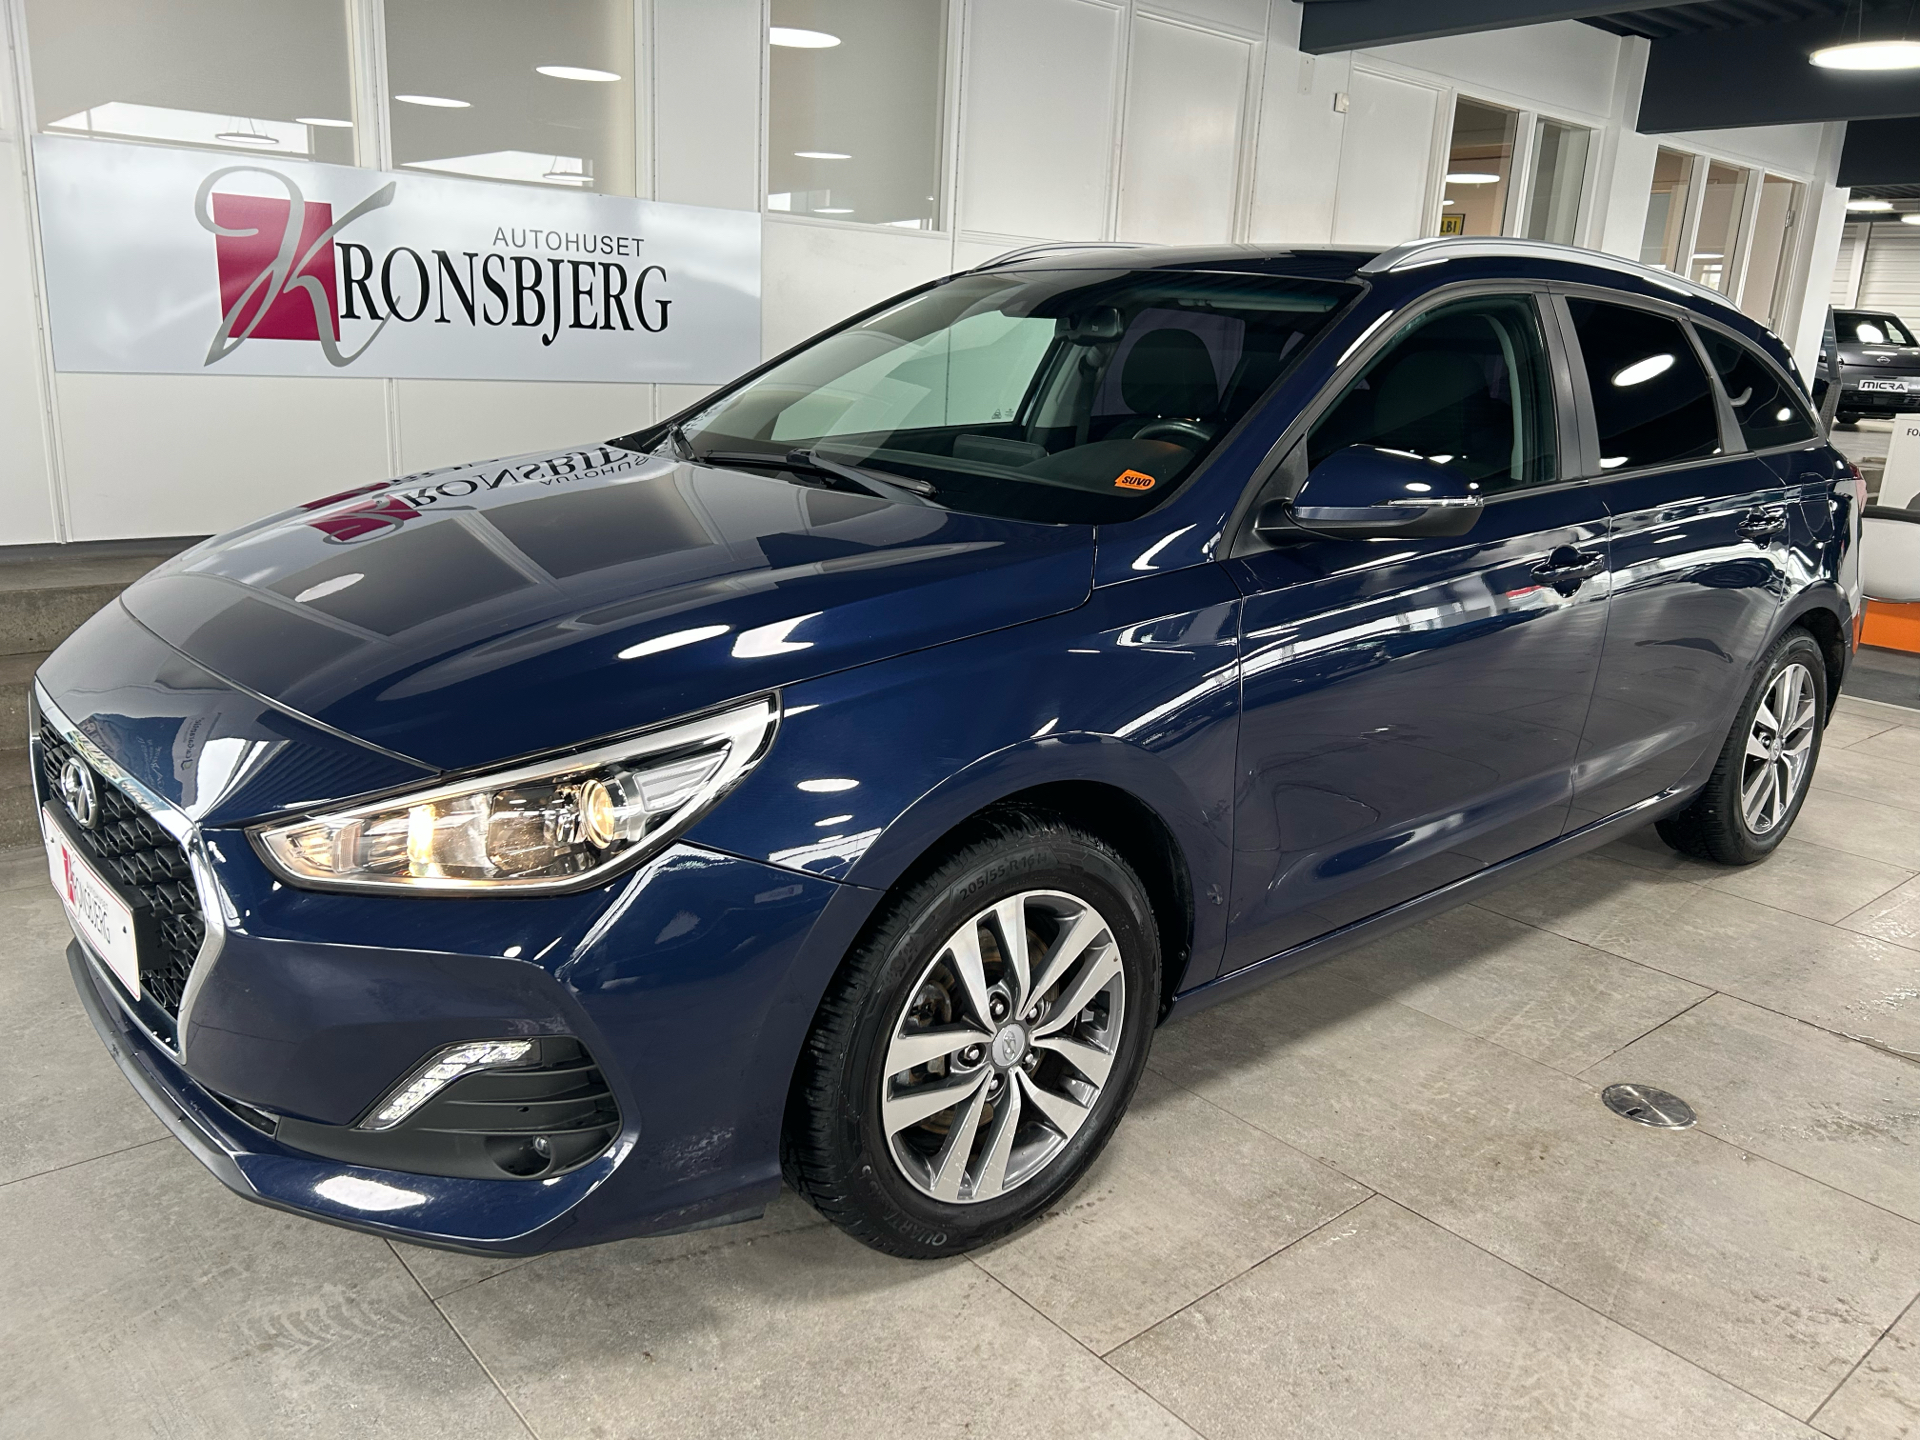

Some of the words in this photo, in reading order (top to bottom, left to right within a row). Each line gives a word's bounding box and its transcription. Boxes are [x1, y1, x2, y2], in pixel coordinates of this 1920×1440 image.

[493, 226, 645, 257] AUTOHUSET
[194, 165, 673, 368] KRONSBJERG
[1861, 381, 1905, 391] MICRA
[1906, 428, 1920, 437] FO
[1121, 475, 1152, 487] SUVO
[959, 864, 1006, 901] 205/55
